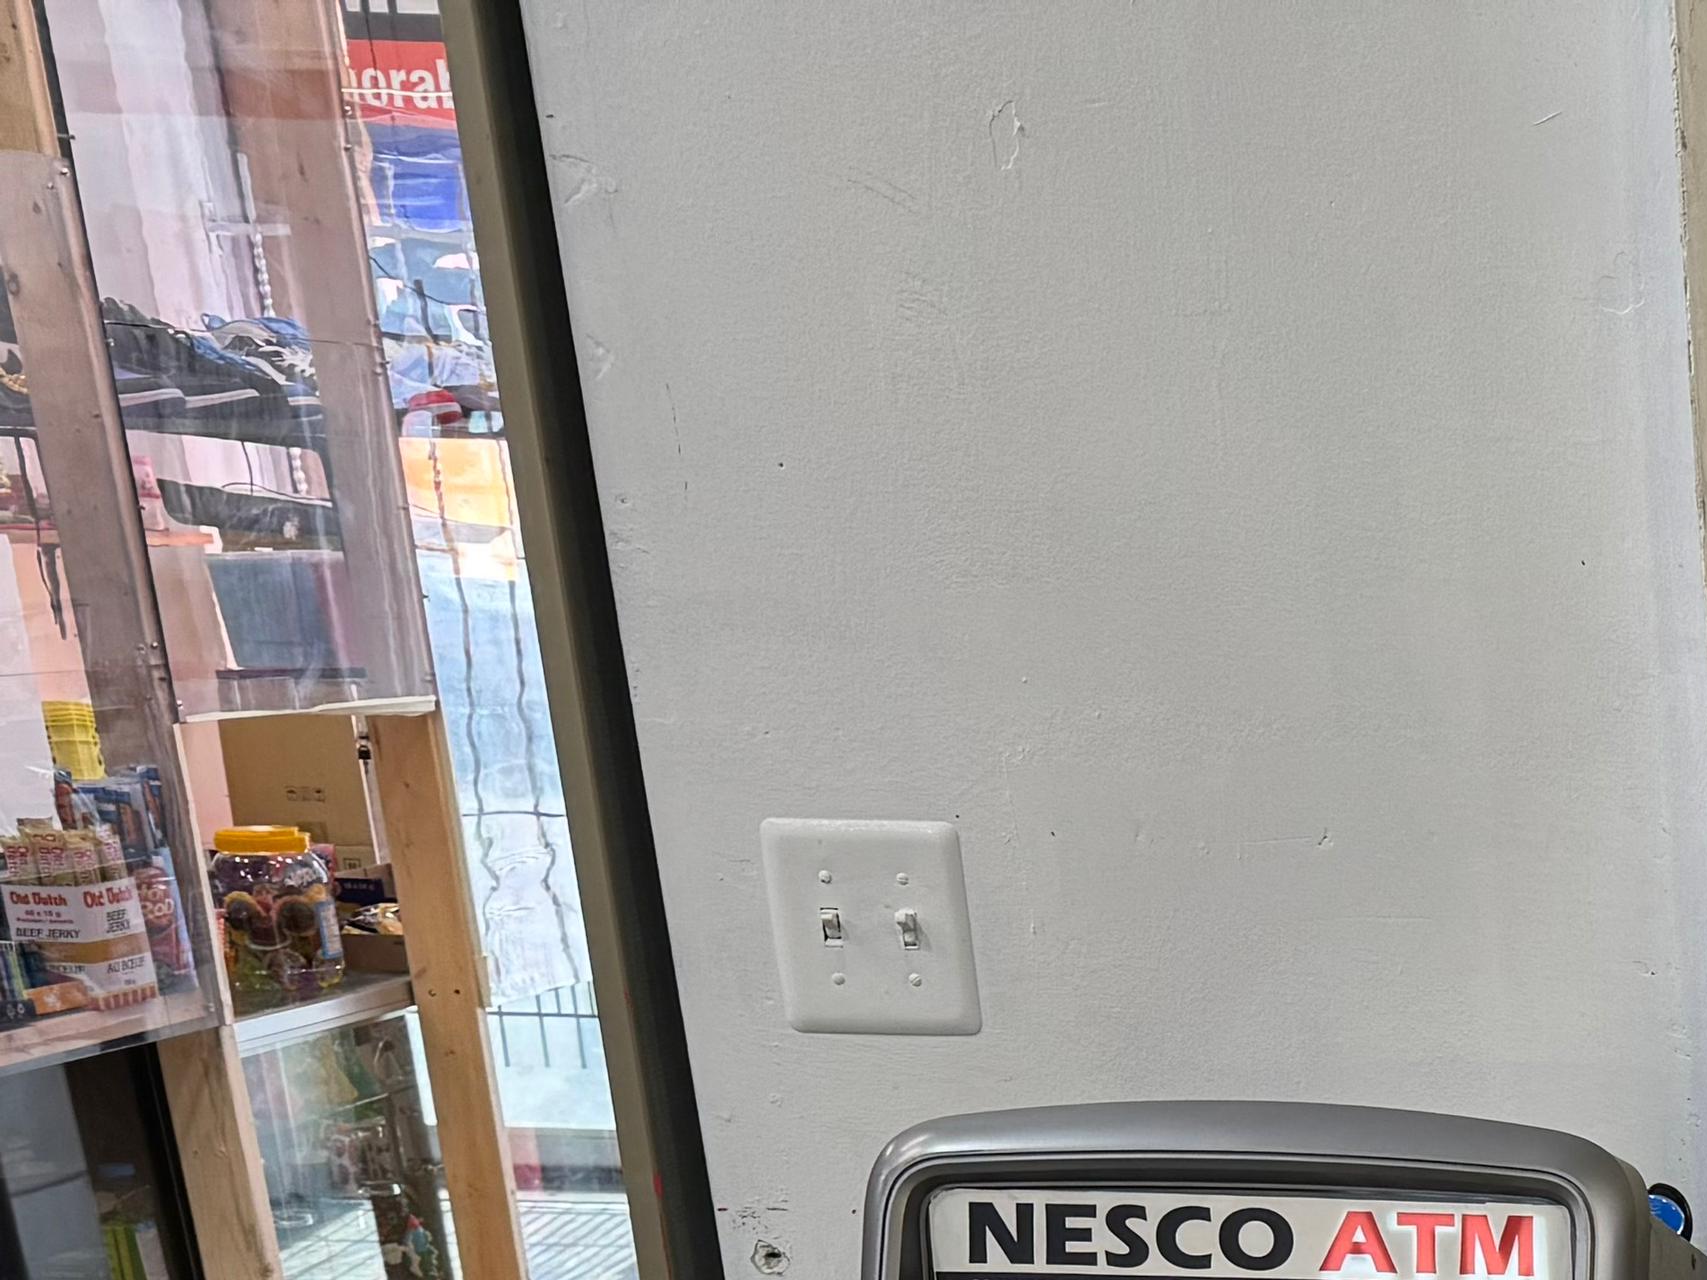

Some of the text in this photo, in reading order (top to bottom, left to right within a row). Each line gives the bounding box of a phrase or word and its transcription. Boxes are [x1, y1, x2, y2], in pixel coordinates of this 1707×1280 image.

[46, 929, 80, 938] JERKY
[968, 1202, 1534, 1276] NESCO ATM
